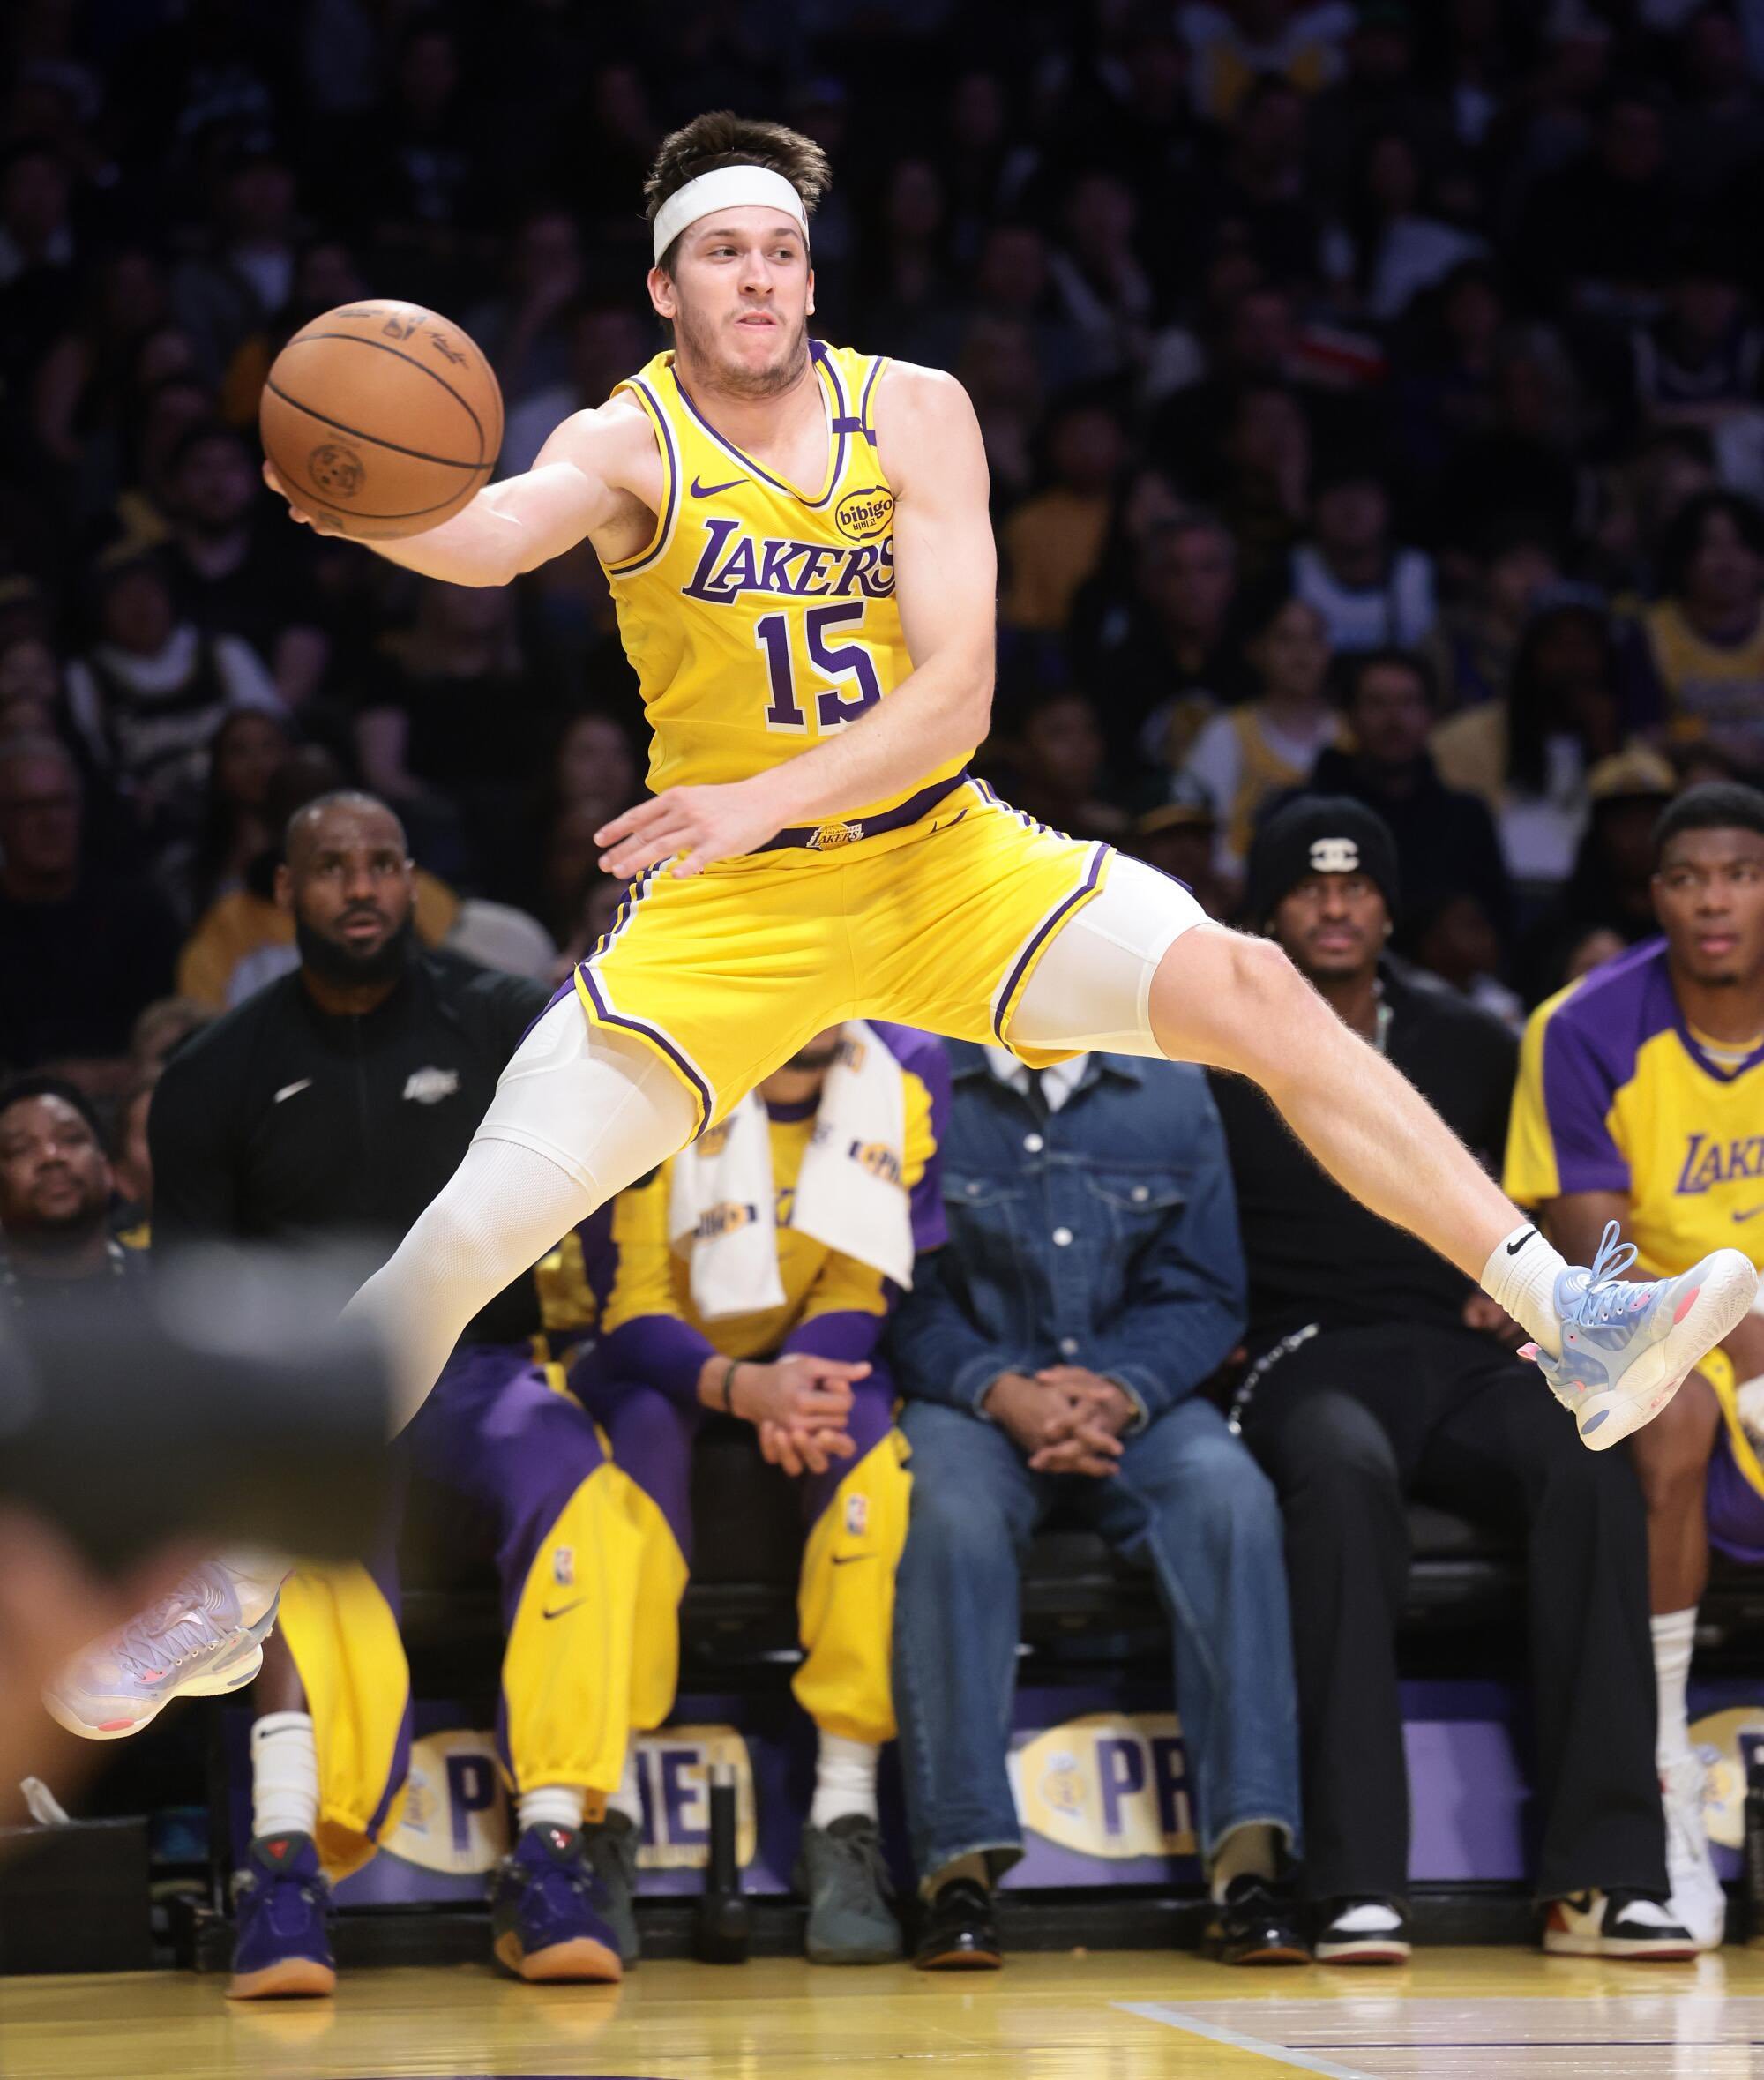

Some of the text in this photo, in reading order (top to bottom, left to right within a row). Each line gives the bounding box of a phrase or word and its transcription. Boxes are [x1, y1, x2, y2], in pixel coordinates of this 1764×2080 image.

[839, 498, 893, 526] bibigo
[853, 519, 876, 531] 비비고
[681, 518, 896, 605] LAKERS
[756, 599, 881, 736] 15
